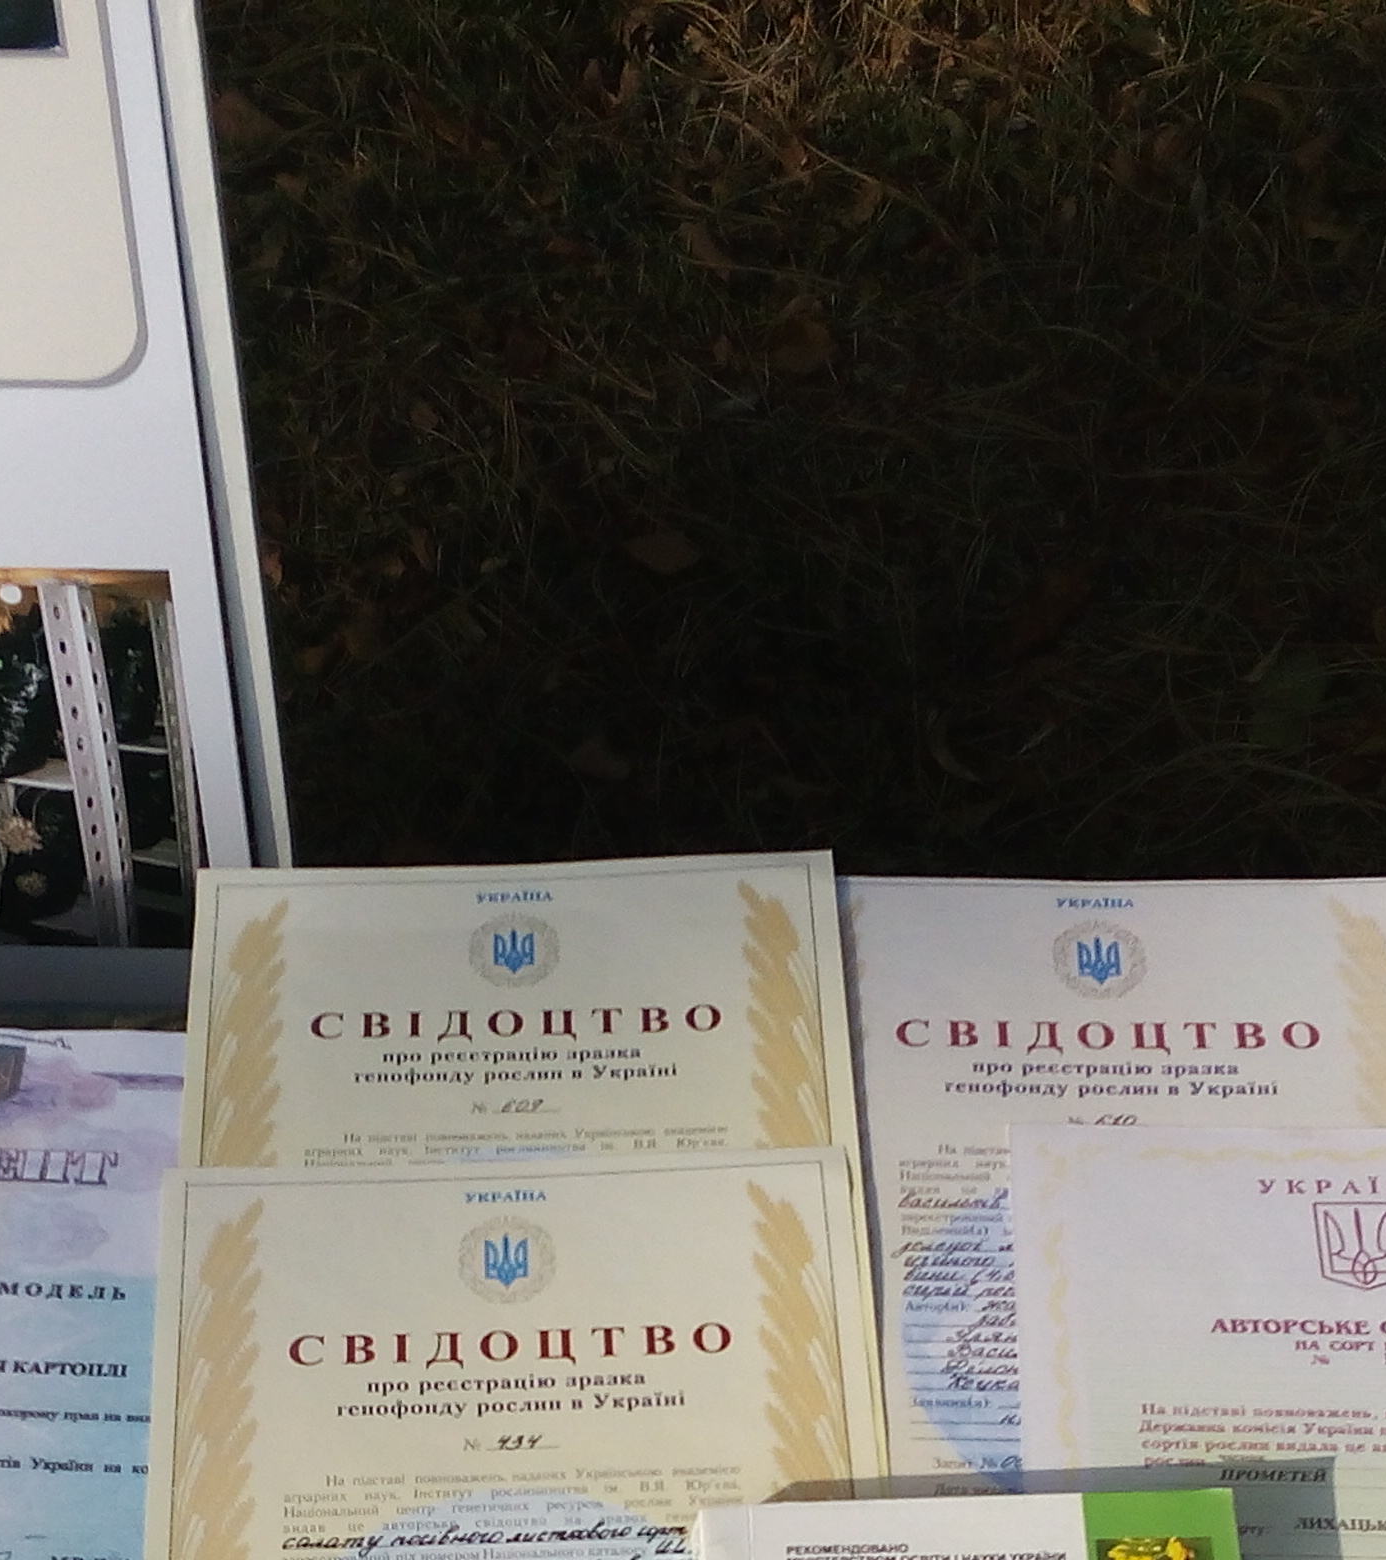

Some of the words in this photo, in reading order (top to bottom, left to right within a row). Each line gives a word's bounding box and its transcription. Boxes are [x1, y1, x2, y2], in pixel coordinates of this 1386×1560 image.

[476, 889, 553, 904] УКРАЇНА
[1056, 896, 1134, 910] УКРАЇНА
[309, 1002, 723, 1044] СВІДОЦТВО
[896, 1018, 1321, 1056] СВІДОЦТВО
[381, 1050, 423, 1067] про
[430, 1047, 559, 1067] реєстрацію
[353, 1066, 475, 1086] генофонду
[483, 1066, 565, 1084] рослин
[592, 1062, 678, 1082] Україні
[972, 1062, 1013, 1078] про
[1021, 1061, 1152, 1079] реєстрацію
[1161, 1060, 1240, 1077] зразка
[944, 1079, 1069, 1099] генофонду
[1077, 1081, 1158, 1097] рослин
[1189, 1079, 1280, 1097] Україні
[464, 1189, 547, 1205] УКРАЇНА
[1210, 1318, 1371, 1335] АВТОРСЬКЕ
[287, 1320, 735, 1370] СВІДОЦТВО
[13, 1357, 128, 1380] КАРТОПЛІ
[366, 1378, 409, 1397] про
[418, 1374, 556, 1396] реєстрацію
[565, 1370, 646, 1389] зразка
[336, 1397, 468, 1420] генофонду
[476, 1396, 561, 1416] рослин
[593, 1390, 687, 1411] Україні
[1218, 1466, 1327, 1484] ПРОМЕТЕЙ
